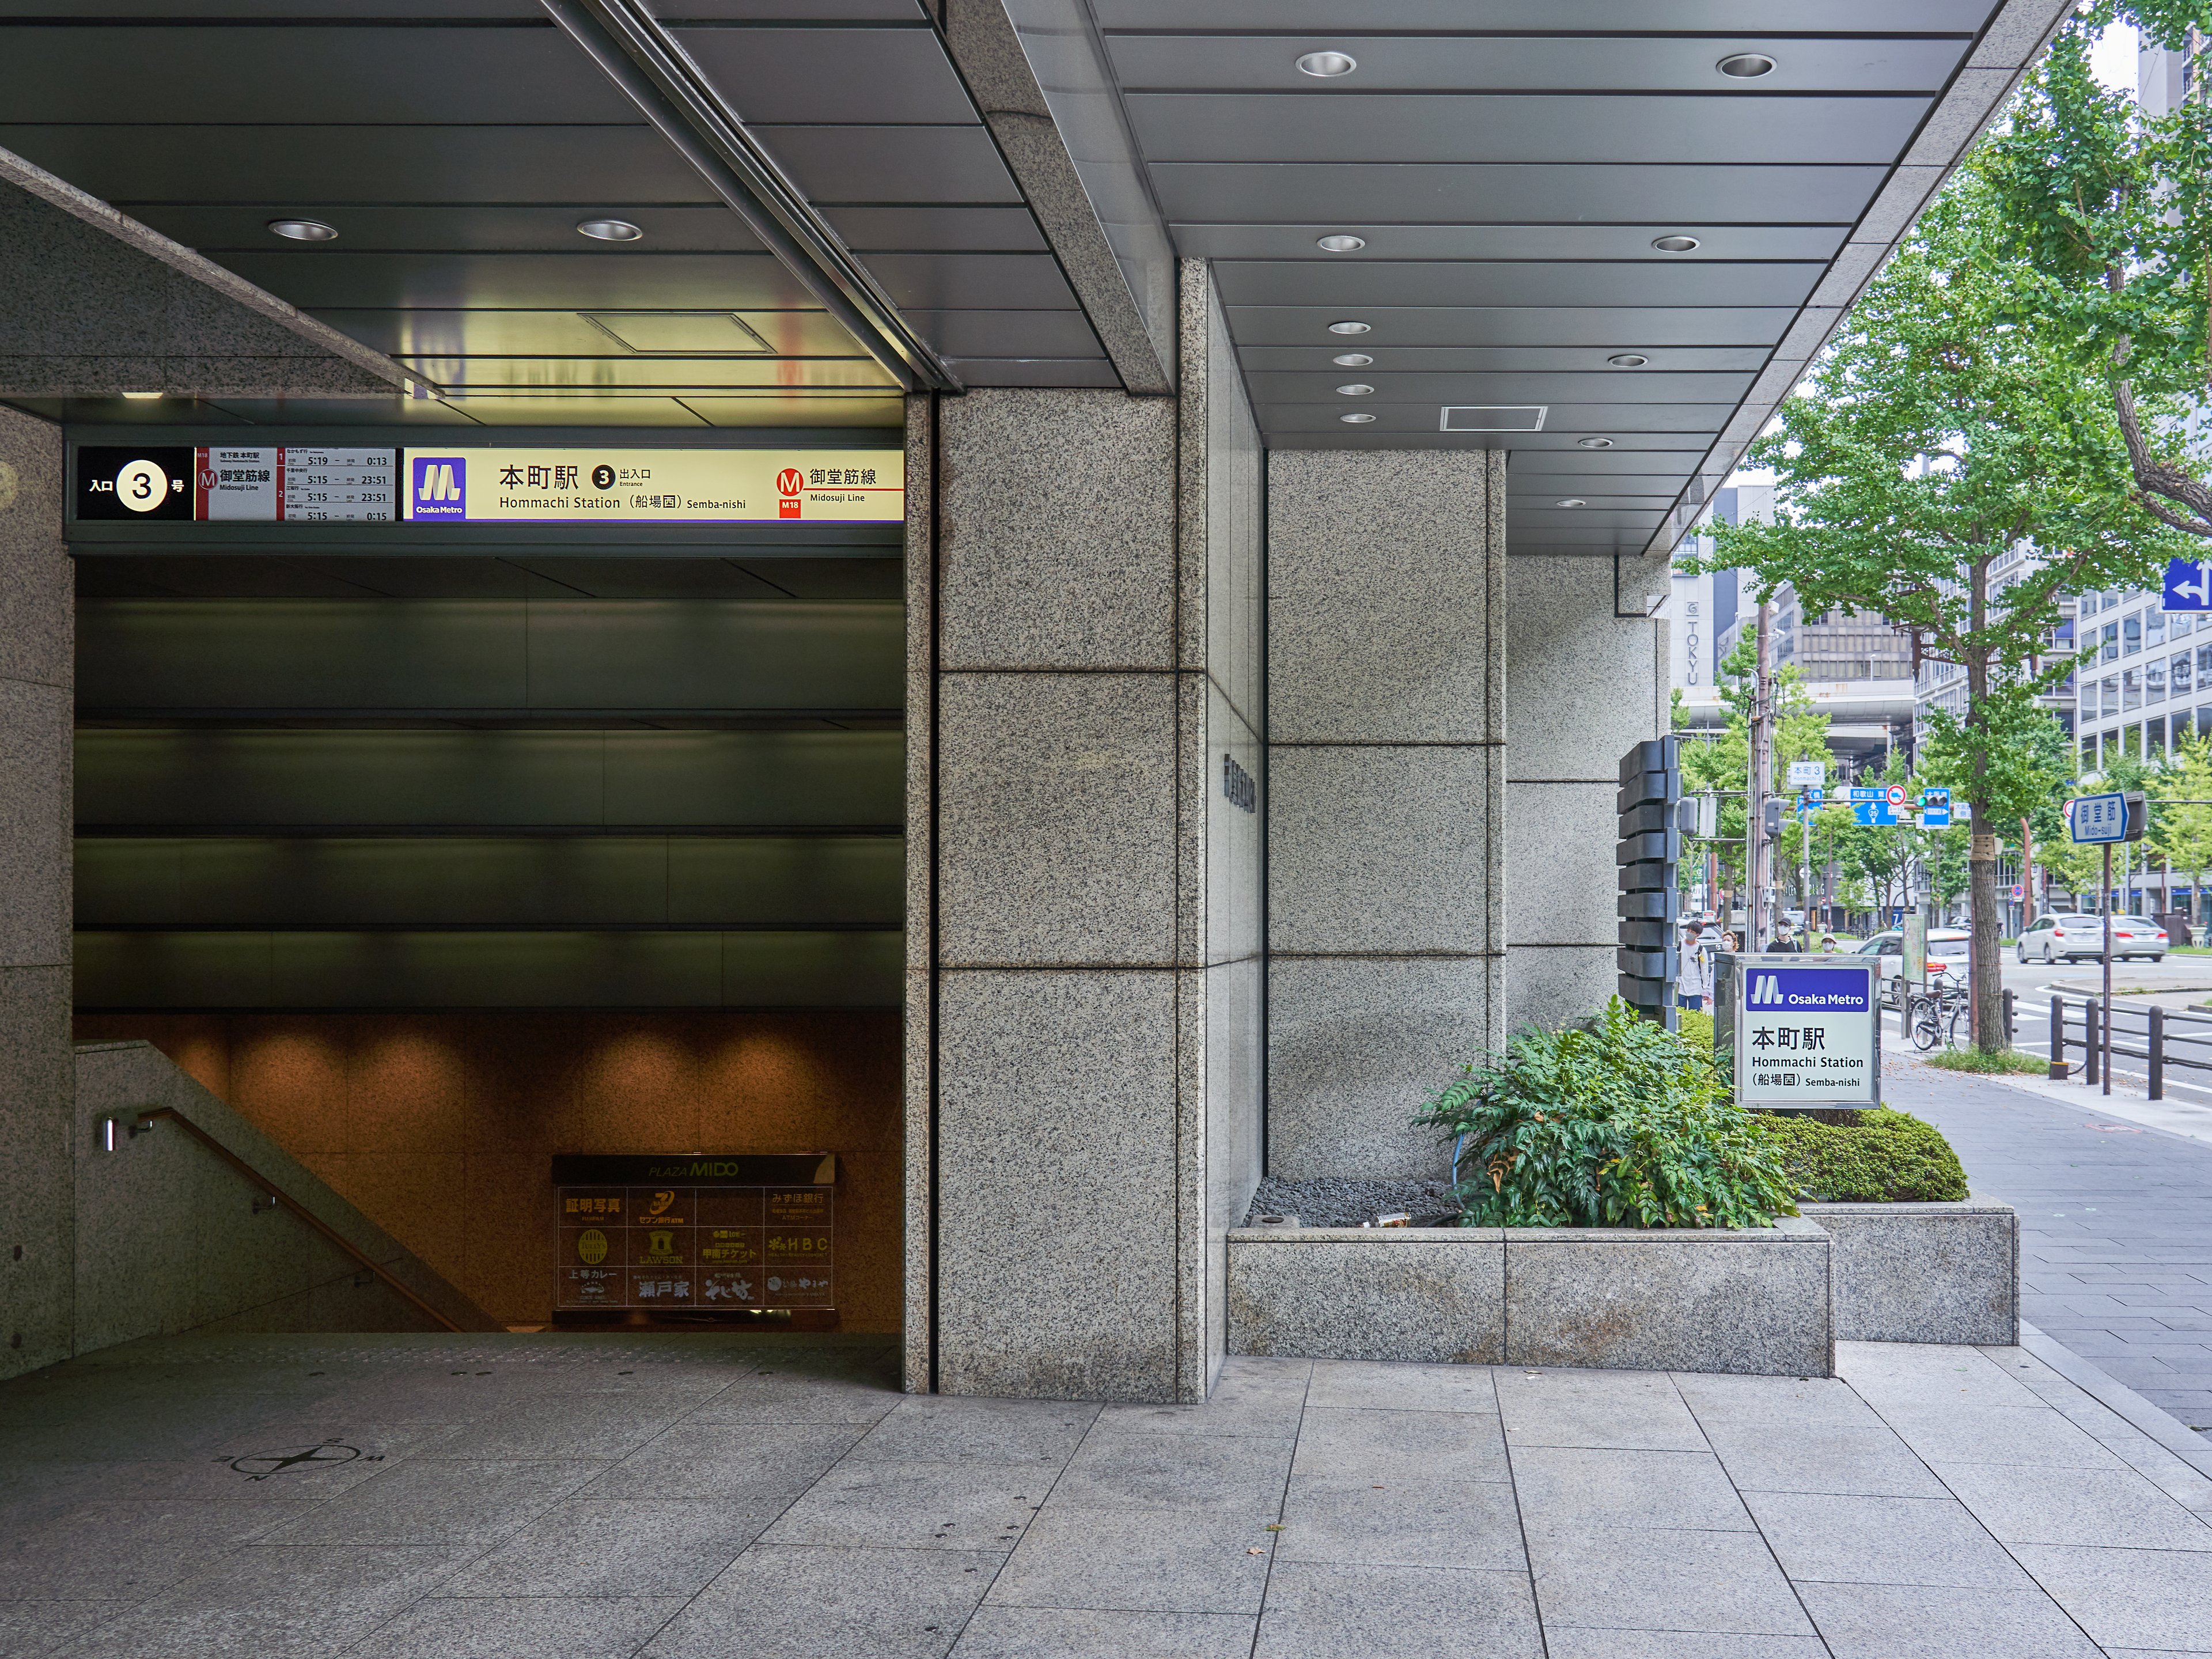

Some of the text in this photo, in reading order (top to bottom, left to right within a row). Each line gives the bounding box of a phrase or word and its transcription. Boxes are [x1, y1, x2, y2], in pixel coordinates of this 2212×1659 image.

[308, 457, 328, 465] 5:19
[367, 457, 387, 465] 0:13
[201, 472, 215, 487] M
[219, 469, 270, 482] 御堂筋線
[308, 475, 328, 484] 5:15
[362, 476, 387, 484] 23:51
[499, 464, 651, 490] 本町駅 3 出入口
[809, 468, 877, 485] 御堂筋線
[89, 472, 184, 500] 入口 3 号
[780, 472, 800, 493] M
[278, 490, 283, 498] 2
[308, 493, 327, 501] 5:15
[361, 493, 386, 502] 23:51
[810, 493, 865, 503] Midosuji Line
[499, 496, 569, 509] Hommachi
[573, 496, 620, 509] Station
[687, 499, 746, 509] Semba-nishi
[416, 506, 463, 514] Osaka Metro
[308, 512, 327, 520] 5:15
[367, 512, 387, 521] 0:15
[1687, 621, 1699, 685] TOKYU
[1794, 766, 1820, 775] 本町 3
[1853, 790, 1874, 798] 和歌山
[2084, 823, 2112, 836] Mido-suji
[1788, 994, 1864, 1005] Osaka Metro
[1752, 1026, 1825, 1051] 本町駅
[1752, 1056, 1863, 1068] Hommachi Station
[1805, 1078, 1860, 1087] Semba-nishi
[649, 1161, 739, 1177] PLAZA MIDO
[772, 1193, 824, 1204] みずほ銀行
[566, 1198, 620, 1213] 証明写真
[702, 1248, 757, 1259] 甲南チケット
[639, 1256, 683, 1264] LAWSON
[638, 1281, 690, 1298] 瀬戸家
